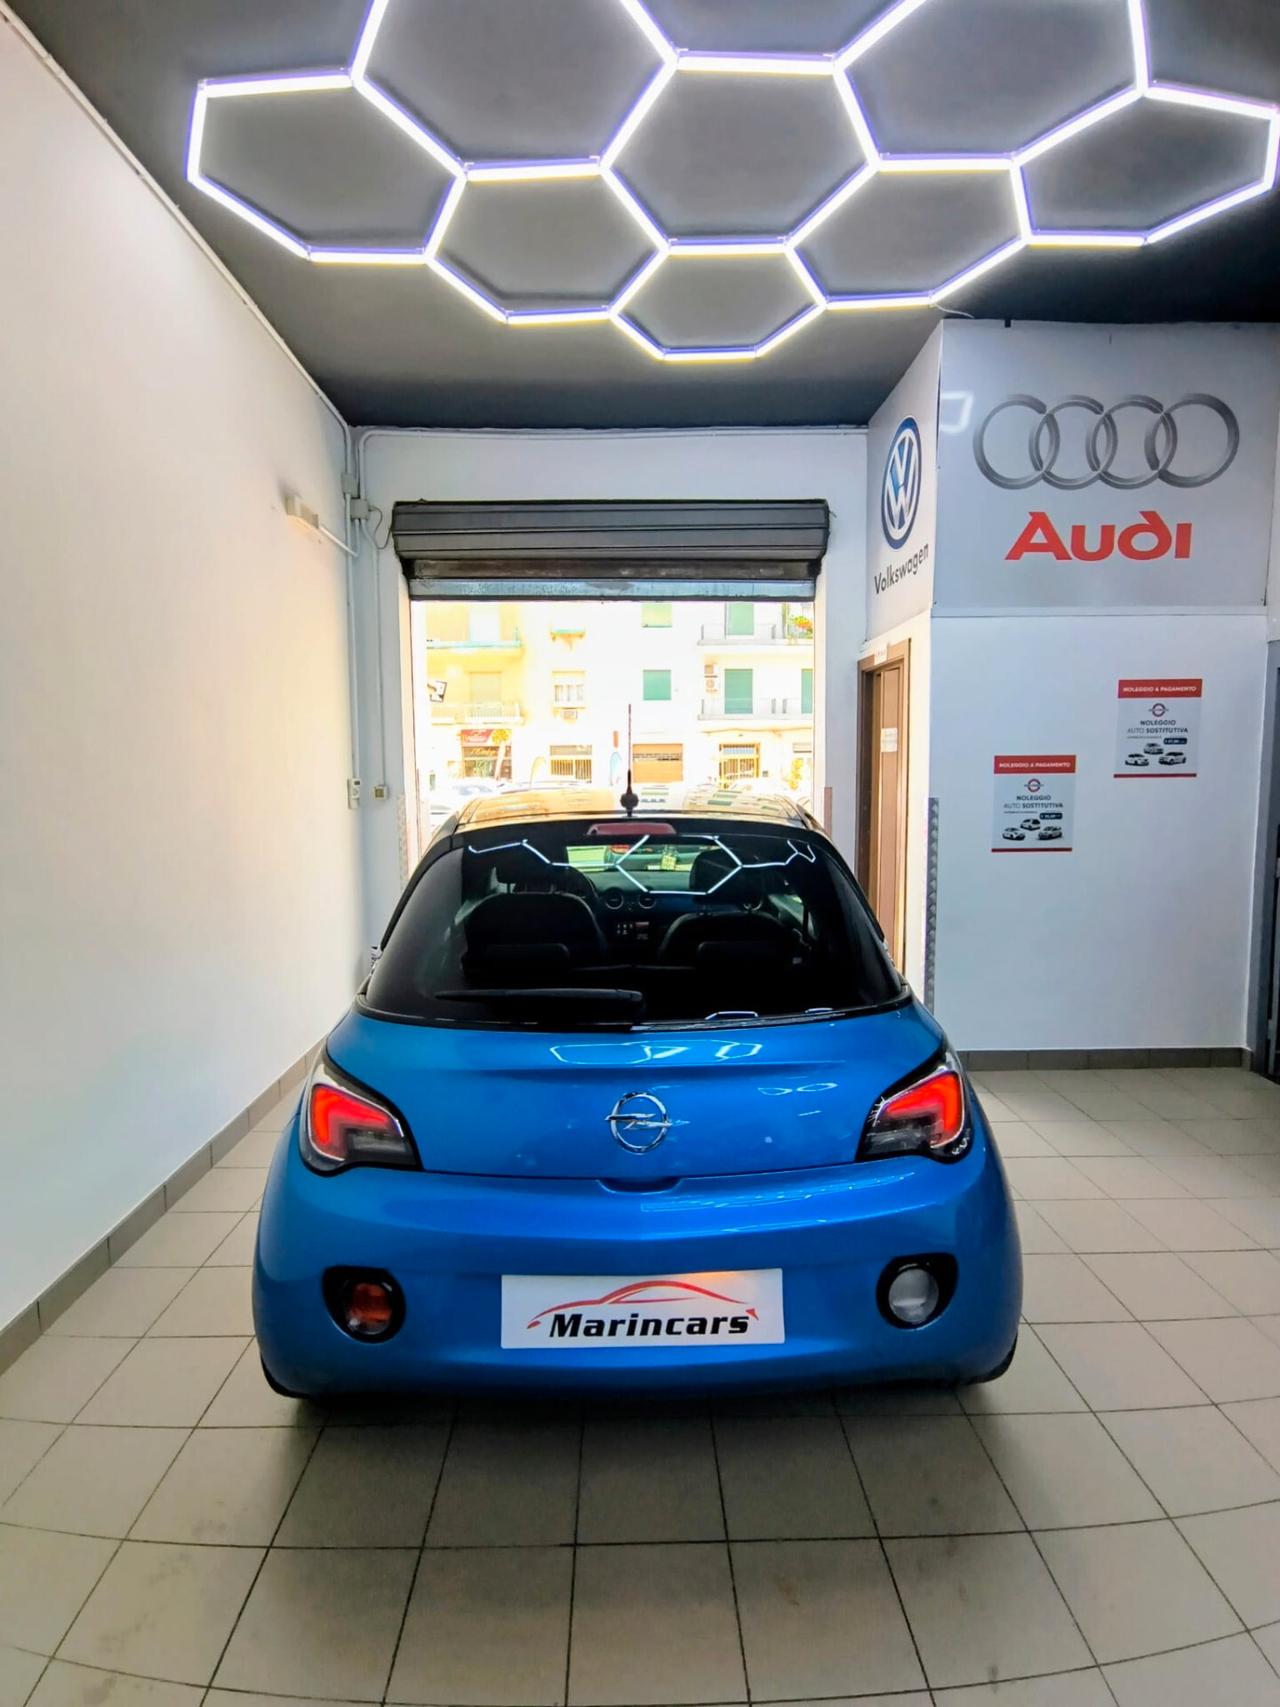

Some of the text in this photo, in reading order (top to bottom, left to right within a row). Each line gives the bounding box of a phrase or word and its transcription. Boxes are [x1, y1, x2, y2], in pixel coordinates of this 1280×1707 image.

[1004, 510, 1193, 561] Audi
[874, 543, 929, 594] Volkswagen
[549, 1312, 750, 1338] Marincars
